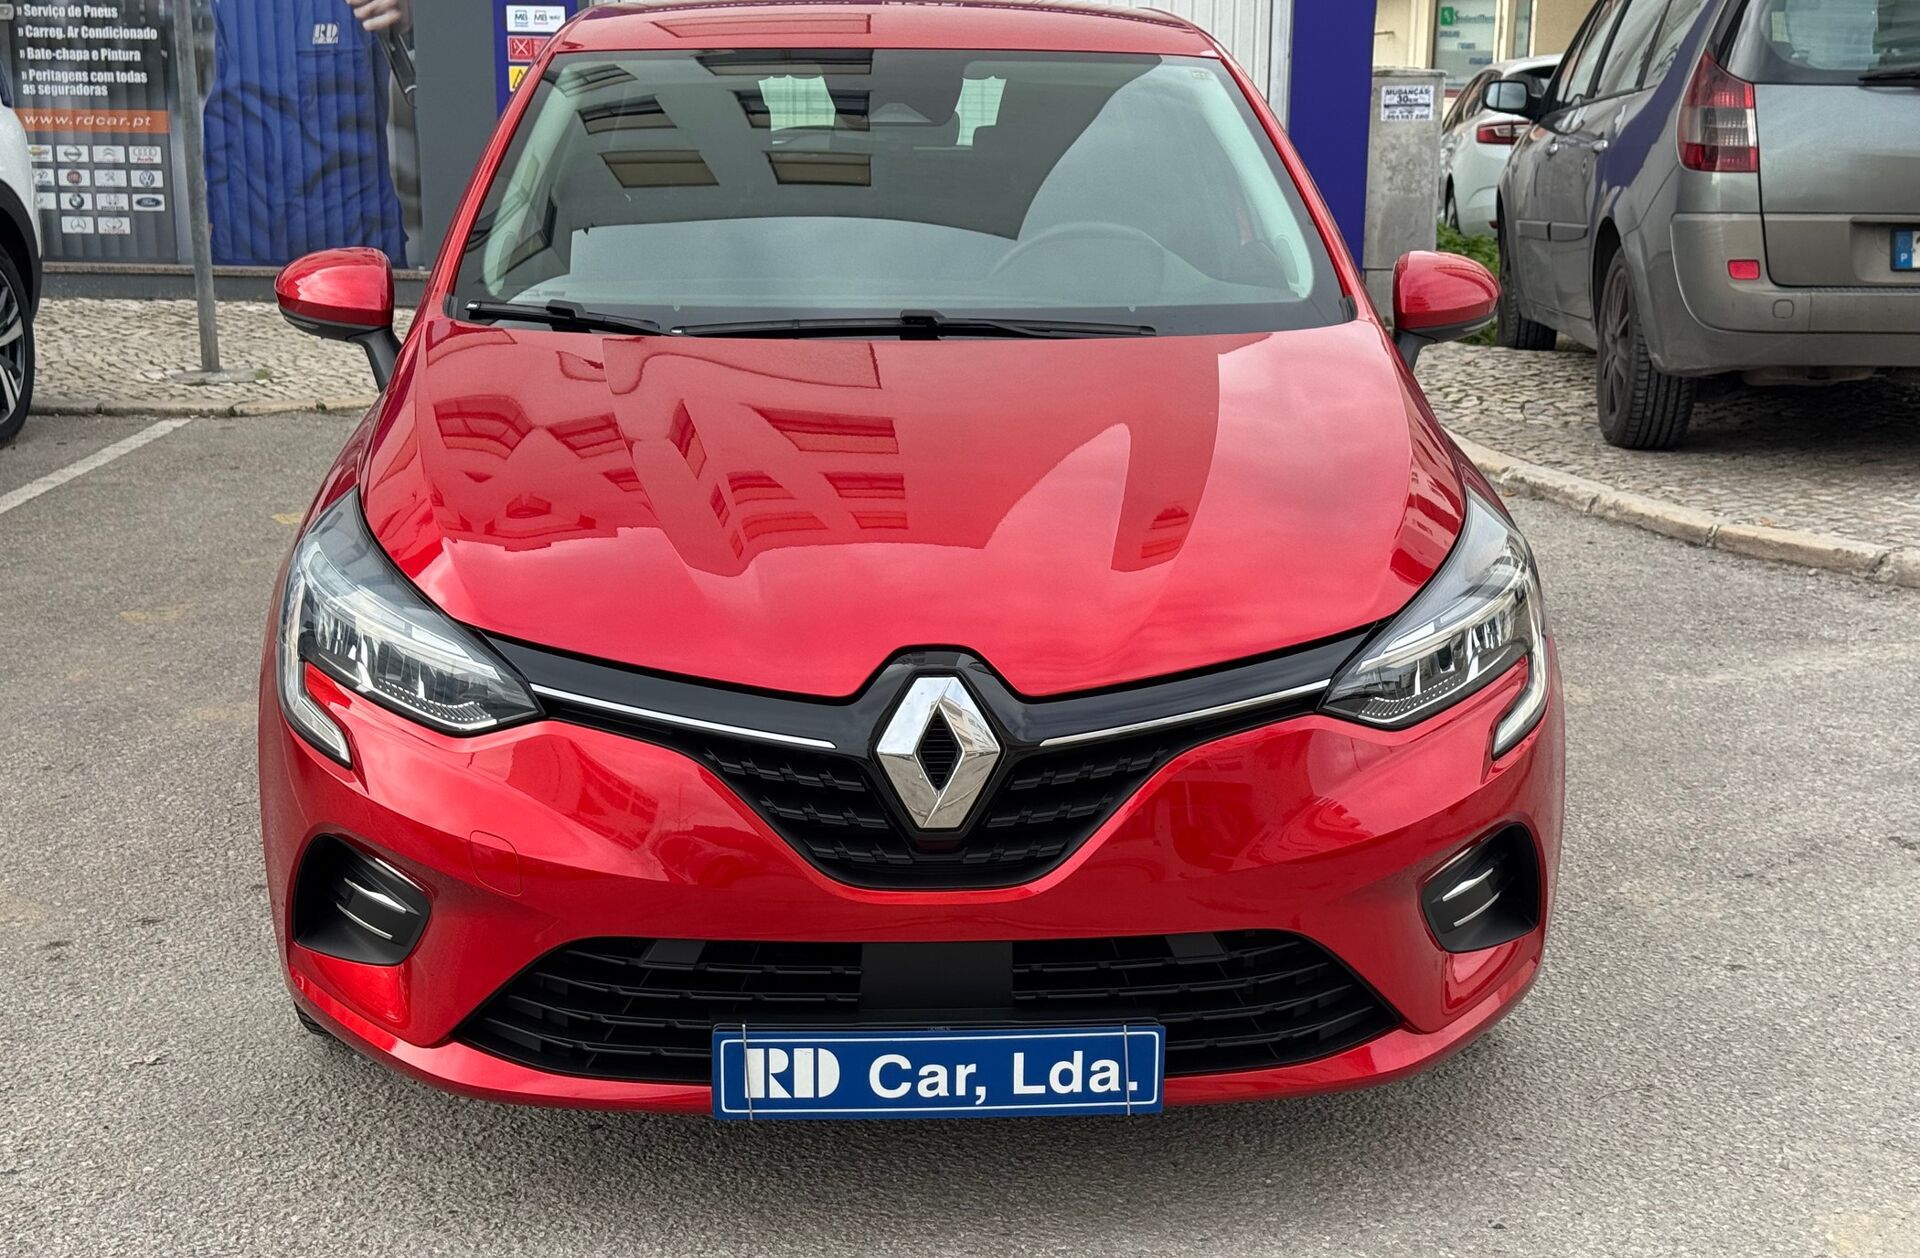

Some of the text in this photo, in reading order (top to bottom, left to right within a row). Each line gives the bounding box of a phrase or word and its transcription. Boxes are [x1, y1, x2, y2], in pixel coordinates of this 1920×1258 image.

[24, 4, 118, 19] Serviço de Pneus
[25, 25, 158, 40] Carreg. Ar Condicionado
[26, 47, 141, 61] Bate-chapa e Pintura
[28, 69, 148, 83] Peritagens com todas
[23, 84, 108, 97] as seguradoras
[25, 114, 152, 126] www.rdcar.pt
[1900, 252, 1908, 263] P
[745, 1047, 1139, 1105] RD Car, Lda.
